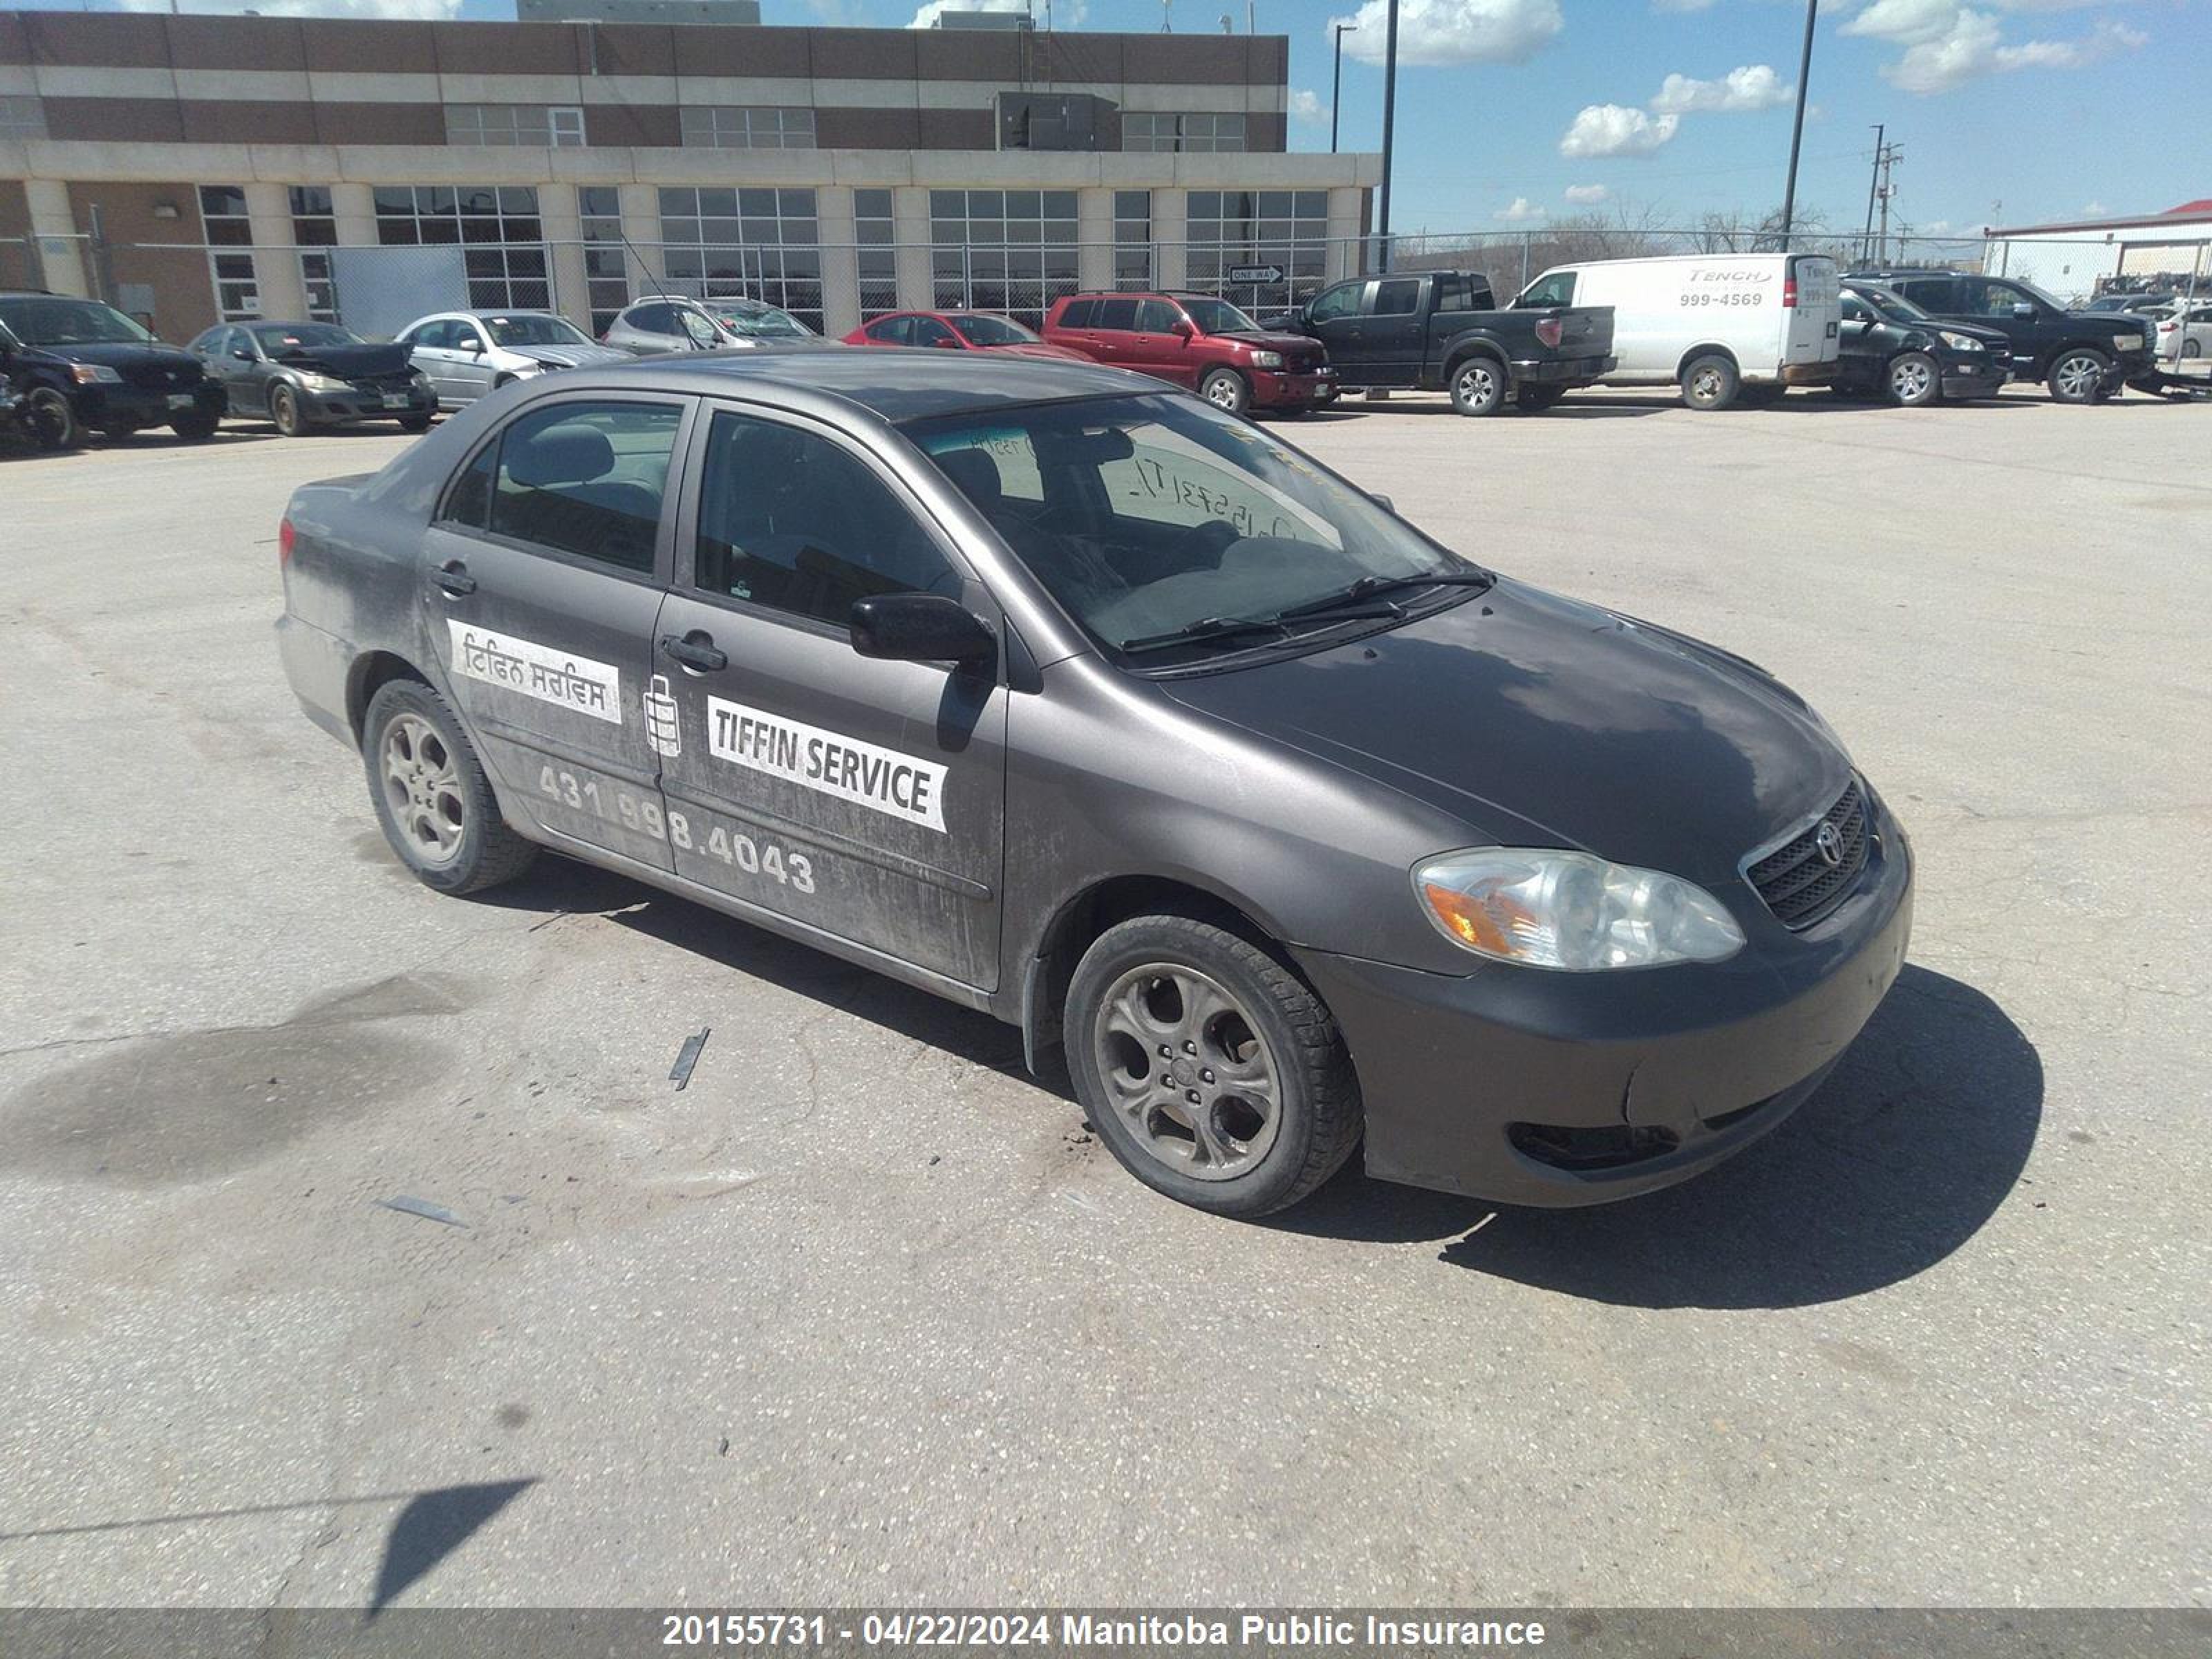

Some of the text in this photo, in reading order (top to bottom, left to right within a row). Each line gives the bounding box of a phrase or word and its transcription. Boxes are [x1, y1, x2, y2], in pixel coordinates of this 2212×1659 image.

[1234, 270, 1252, 279] ONE
[1680, 293, 1762, 306] 999-4569
[462, 632, 607, 711] ਟਿਫਿਨ ਸਰਵਿਸ
[715, 709, 931, 814] TIFFIN SERVICE
[541, 765, 603, 818] 431
